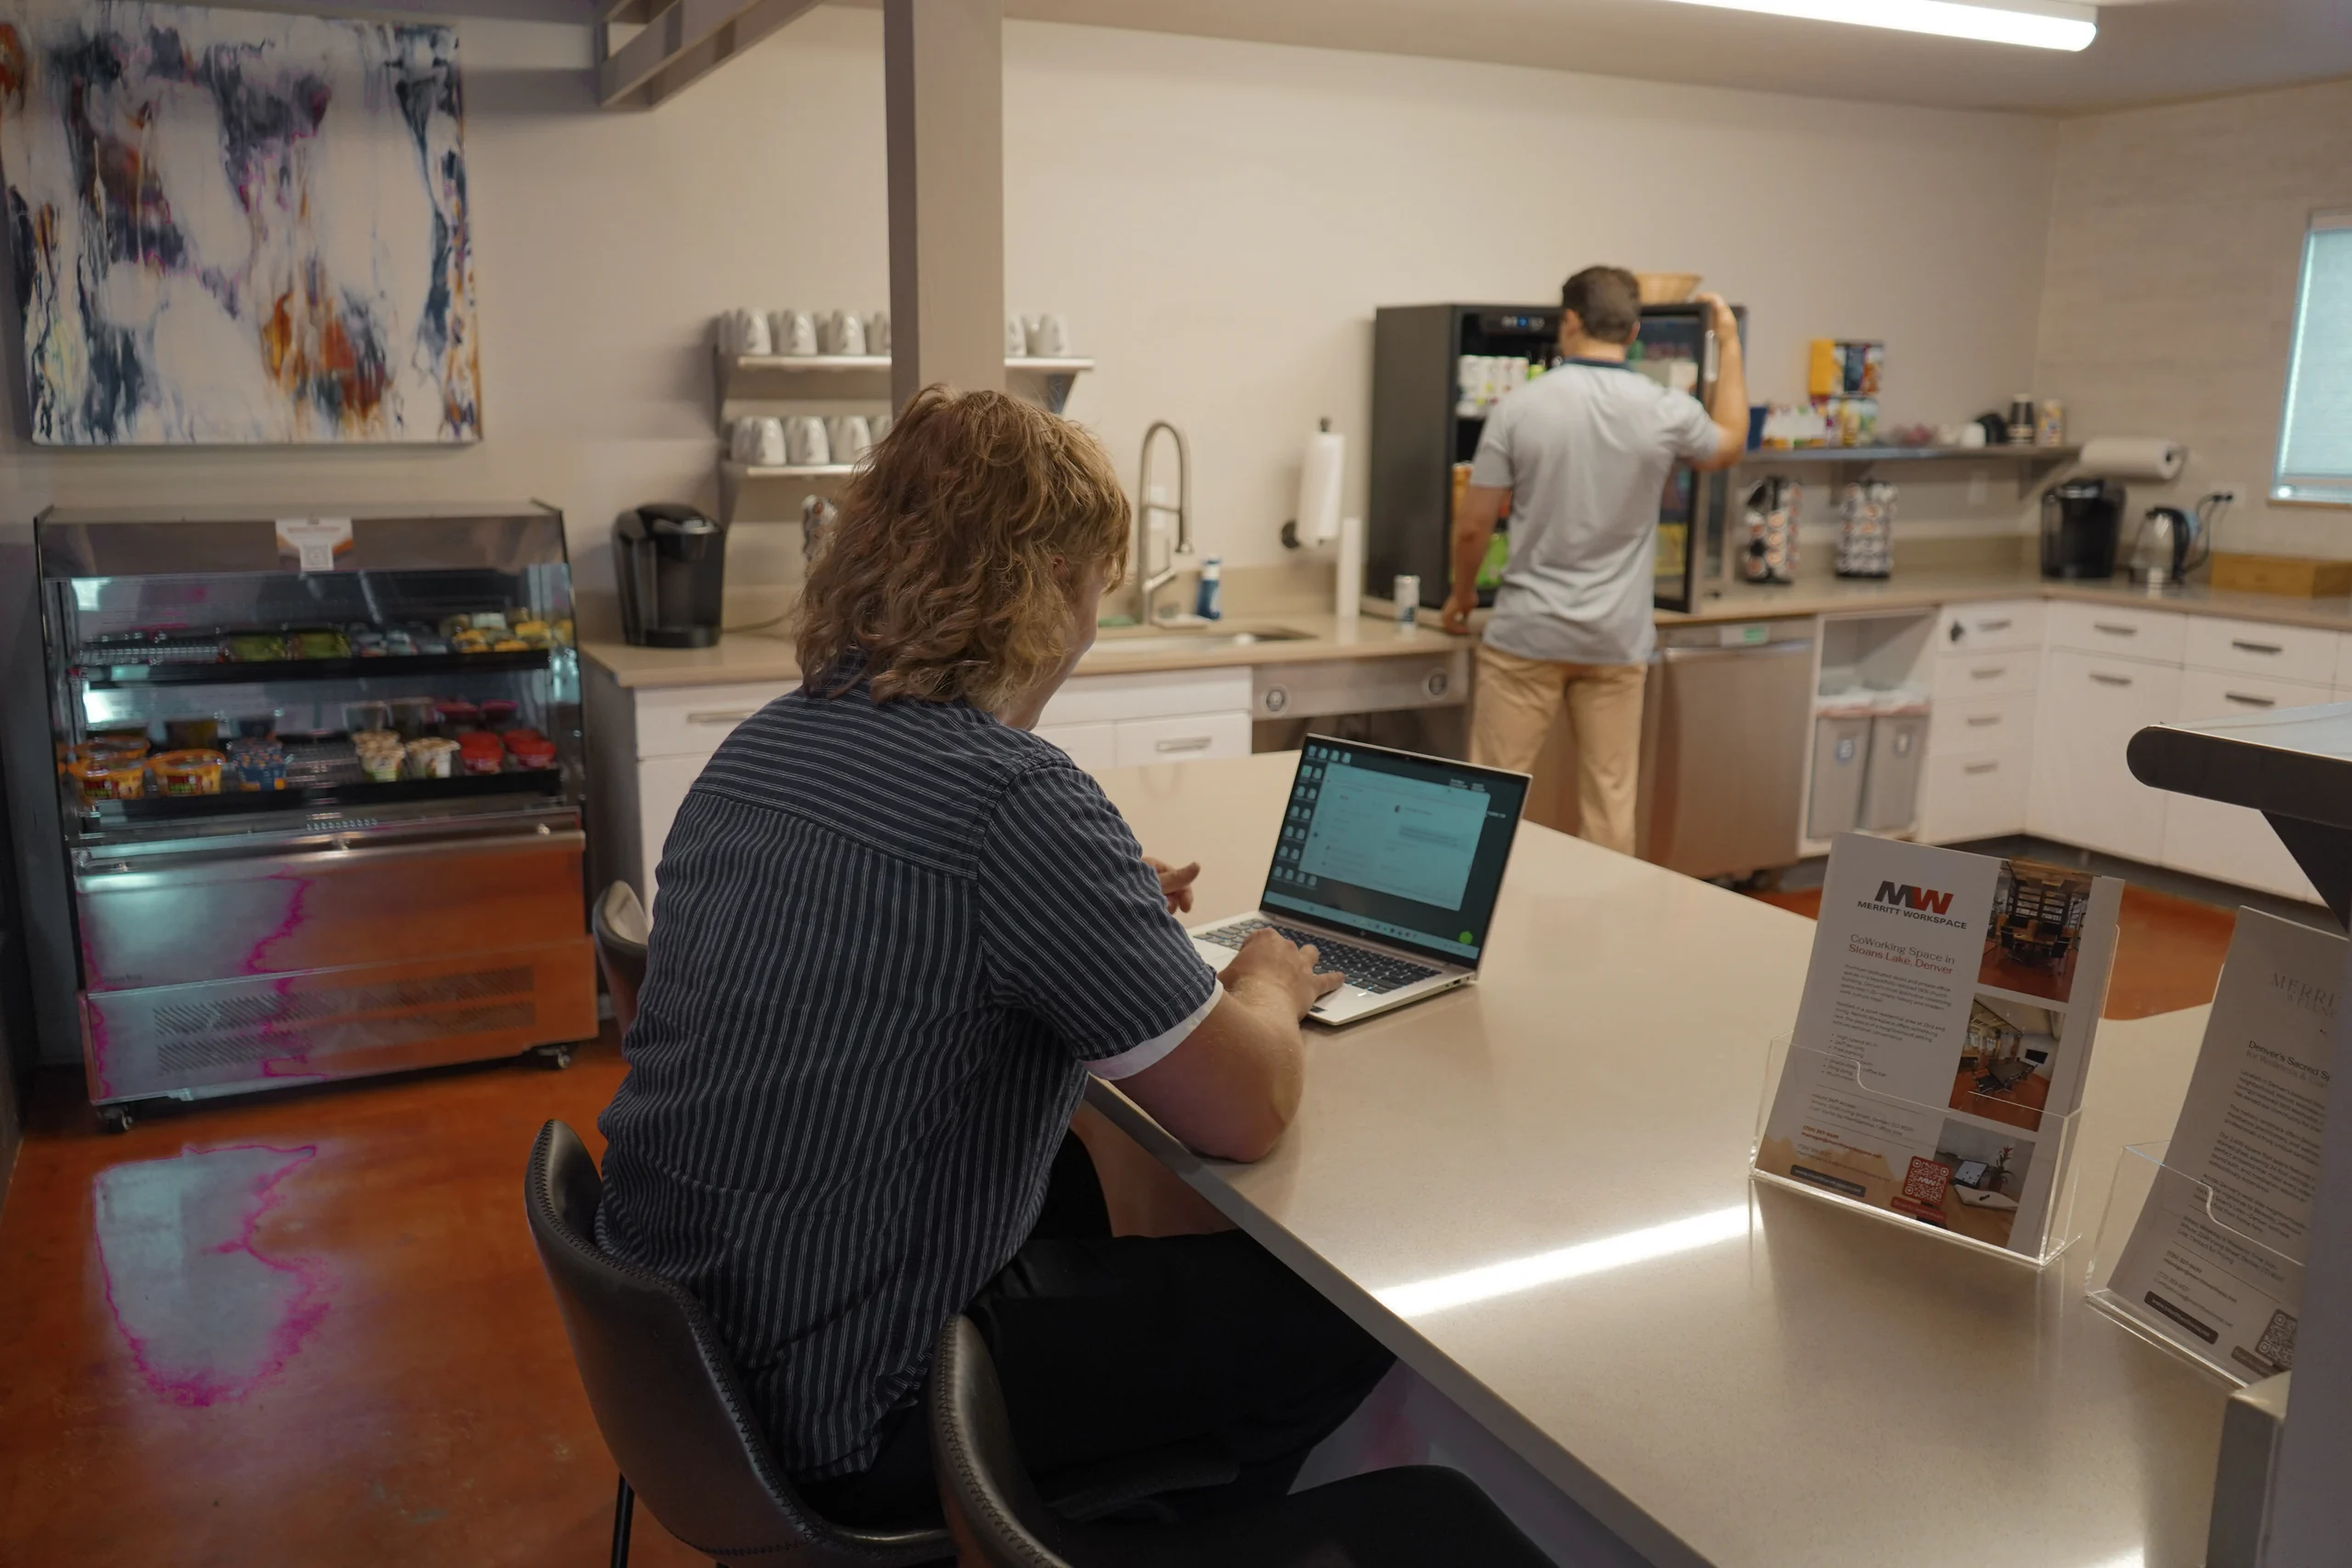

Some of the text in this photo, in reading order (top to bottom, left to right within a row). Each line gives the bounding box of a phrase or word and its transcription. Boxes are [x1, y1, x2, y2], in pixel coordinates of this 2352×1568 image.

[1874, 880, 1953, 915] MW
[1858, 901, 1967, 929] MERRITT WORKSPACE
[1849, 933, 1955, 964] CoWorking Space in
[1849, 944, 1883, 958] Sloans
[1916, 959, 1953, 974] Denver
[2271, 973, 2342, 1010] MERRI
[2248, 1040, 2286, 1063] Denver's
[2287, 1055, 2320, 1077] Sacred
